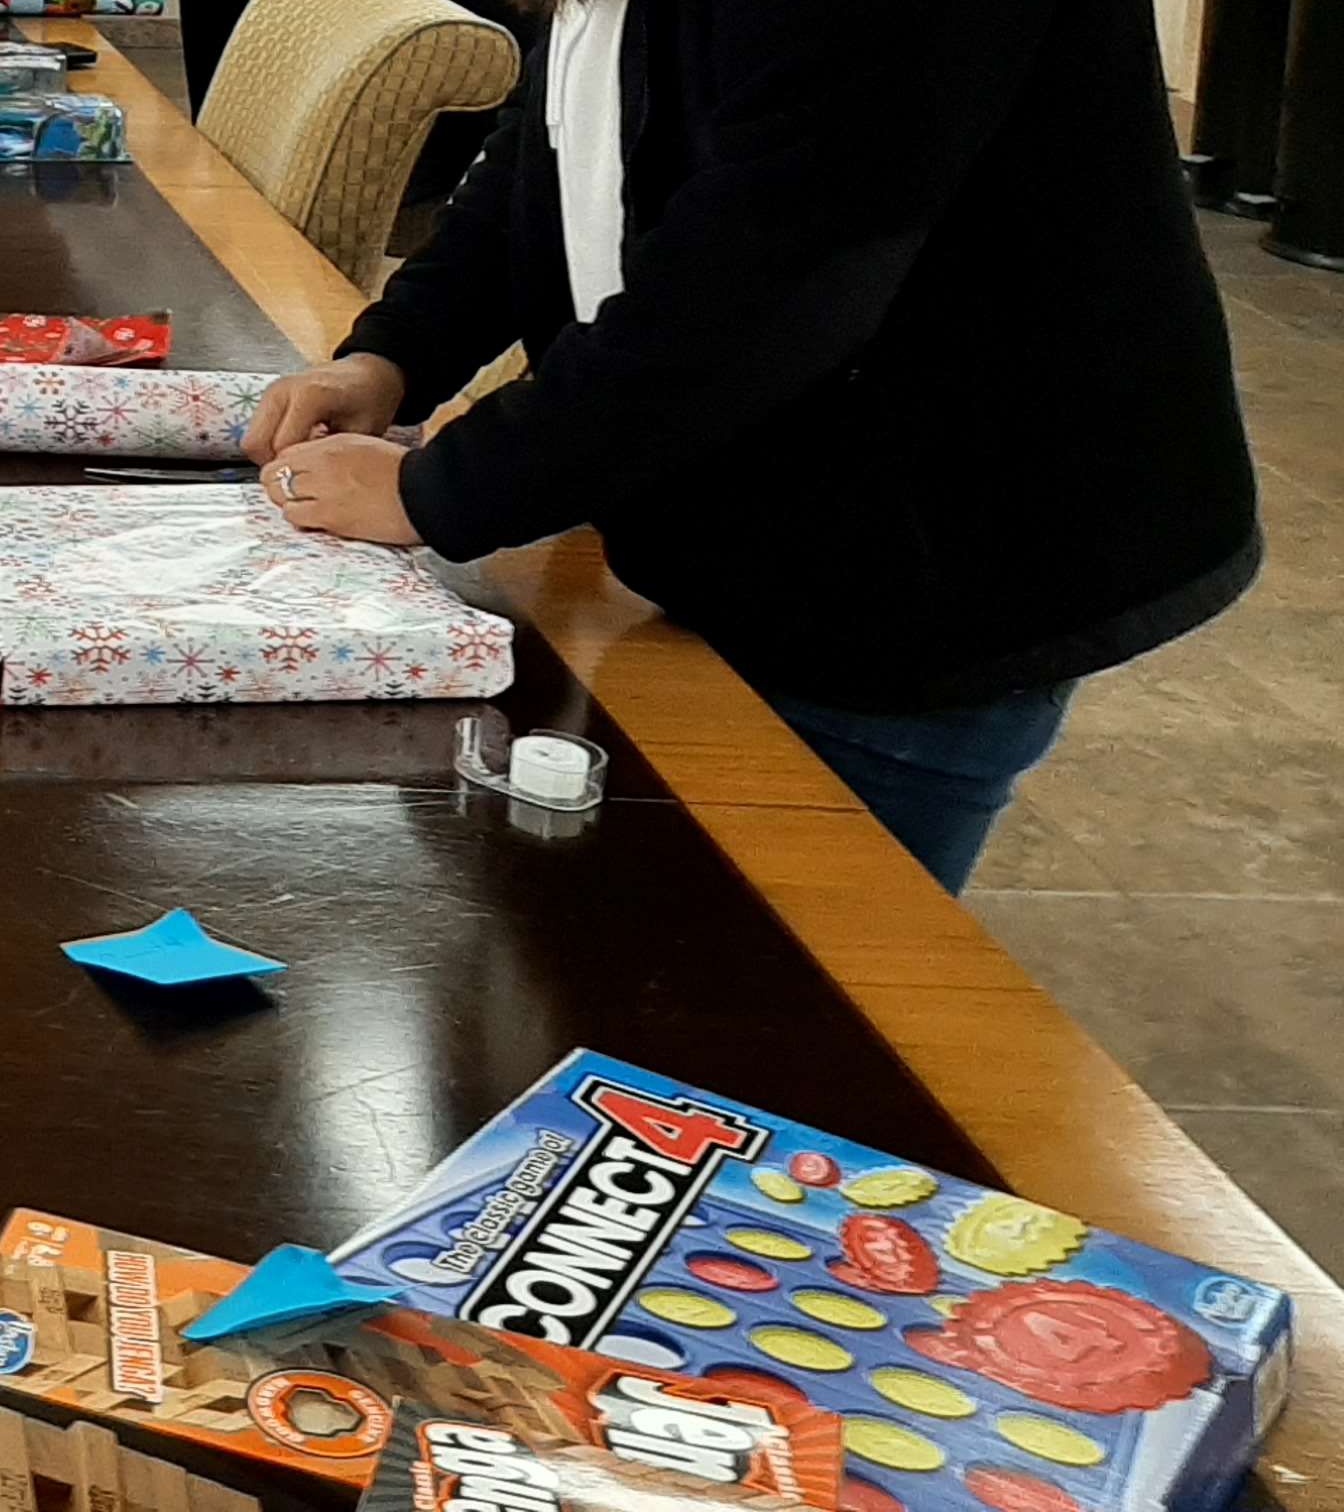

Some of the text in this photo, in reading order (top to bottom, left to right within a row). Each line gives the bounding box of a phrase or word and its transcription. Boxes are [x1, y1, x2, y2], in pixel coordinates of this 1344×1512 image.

[439, 1133, 568, 1272] The classic game of
[478, 1090, 750, 1346] CONNECT 4
[111, 1252, 160, 1401] HOW DO YOU JENGA?
